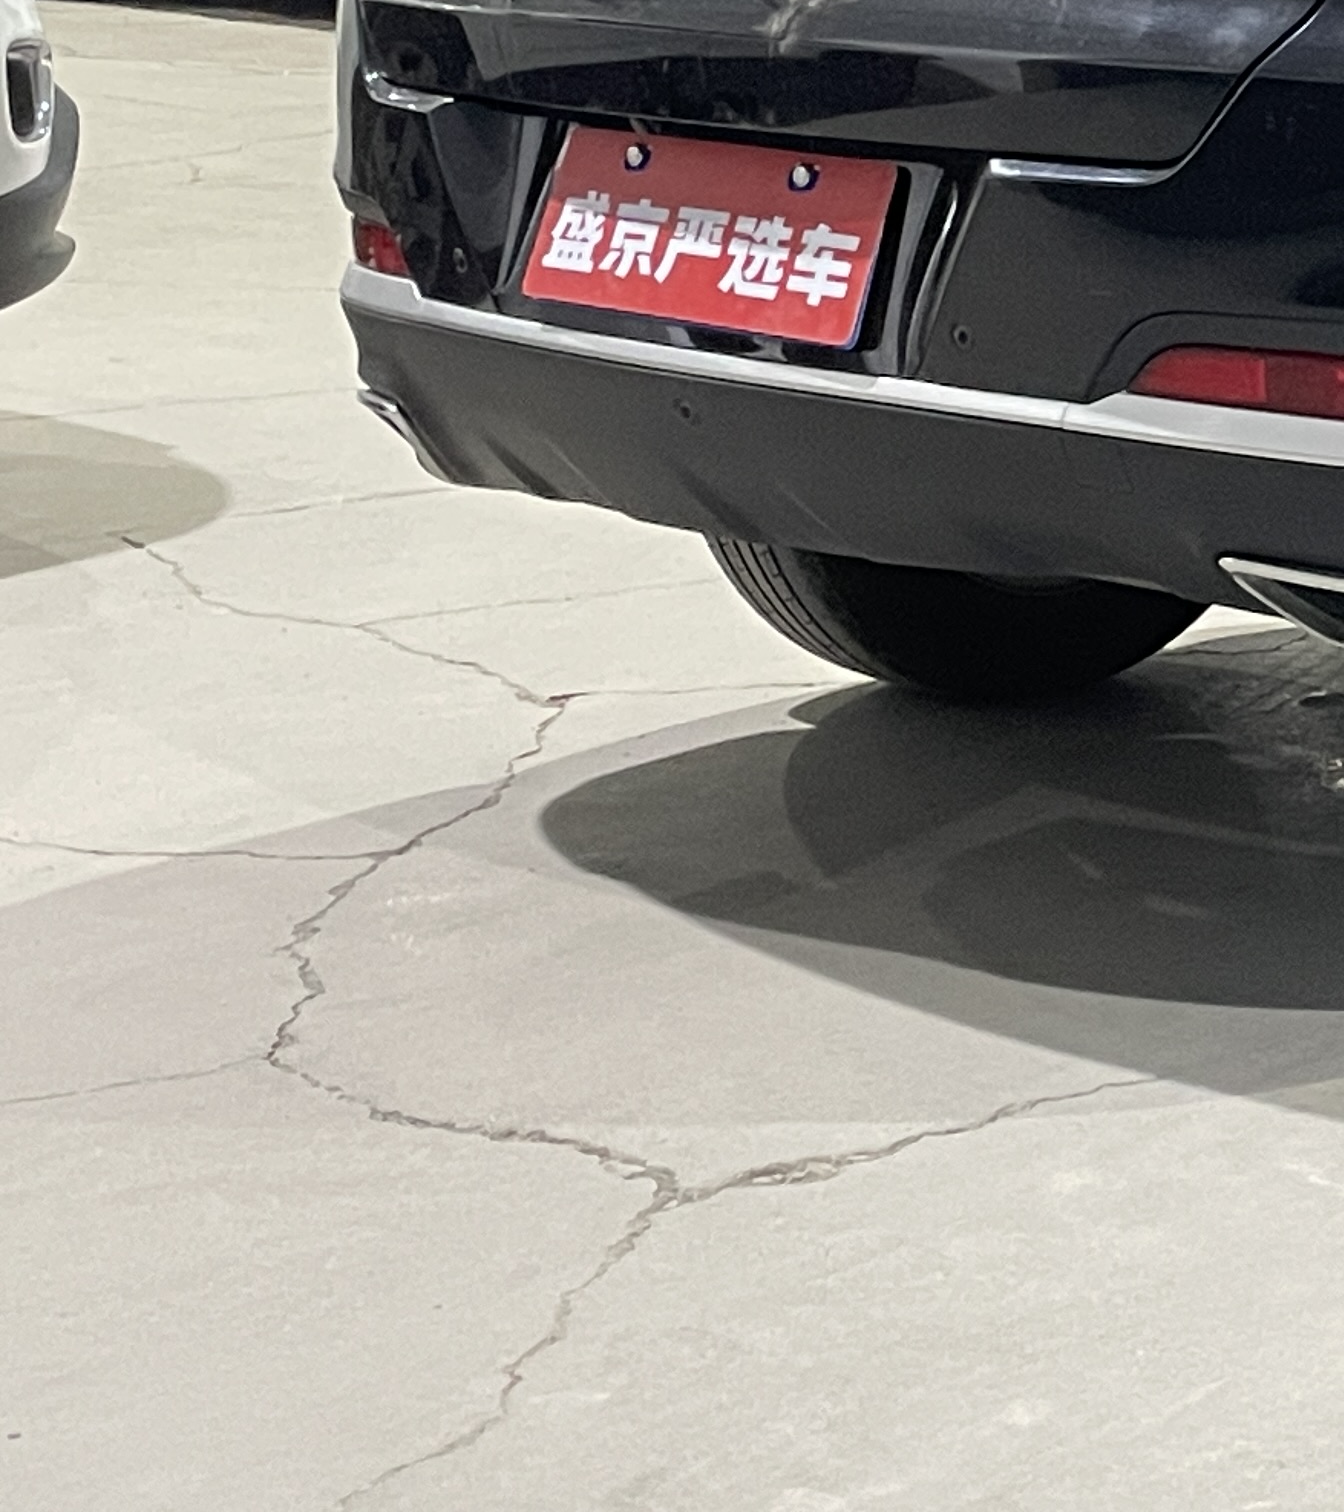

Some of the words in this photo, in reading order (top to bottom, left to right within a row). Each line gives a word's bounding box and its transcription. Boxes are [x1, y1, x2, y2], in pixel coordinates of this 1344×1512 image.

[541, 190, 861, 307] 盛京严选车
